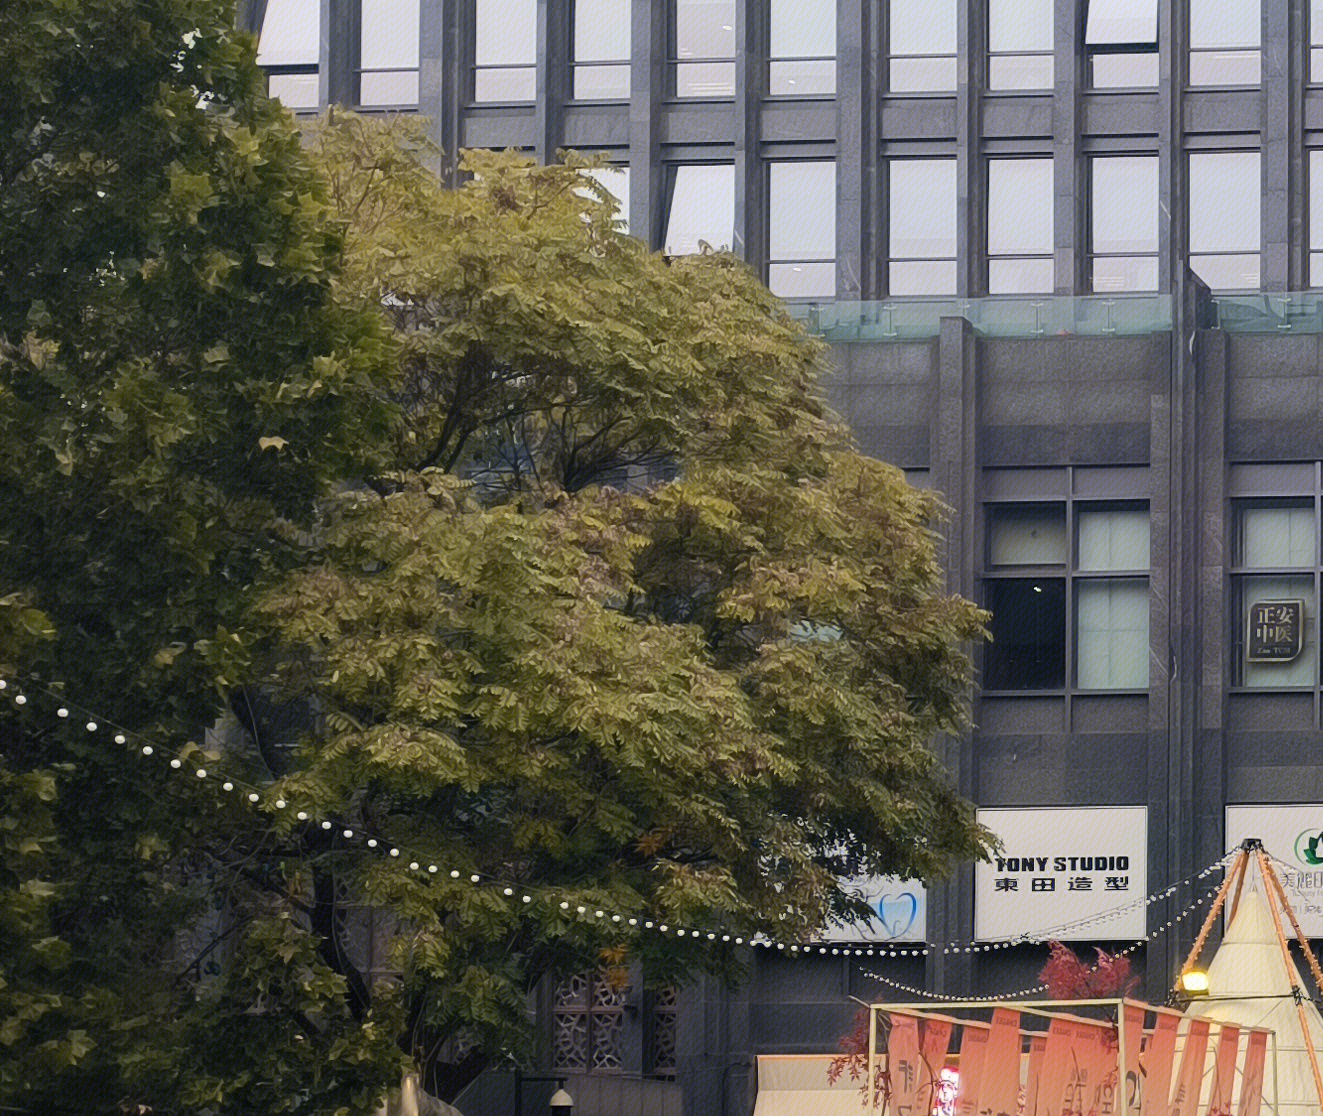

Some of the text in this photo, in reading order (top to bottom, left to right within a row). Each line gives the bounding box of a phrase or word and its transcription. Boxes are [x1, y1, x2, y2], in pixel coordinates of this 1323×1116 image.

[995, 856, 1129, 872] TONY STUDIO
[994, 875, 1129, 893] 東田造型
